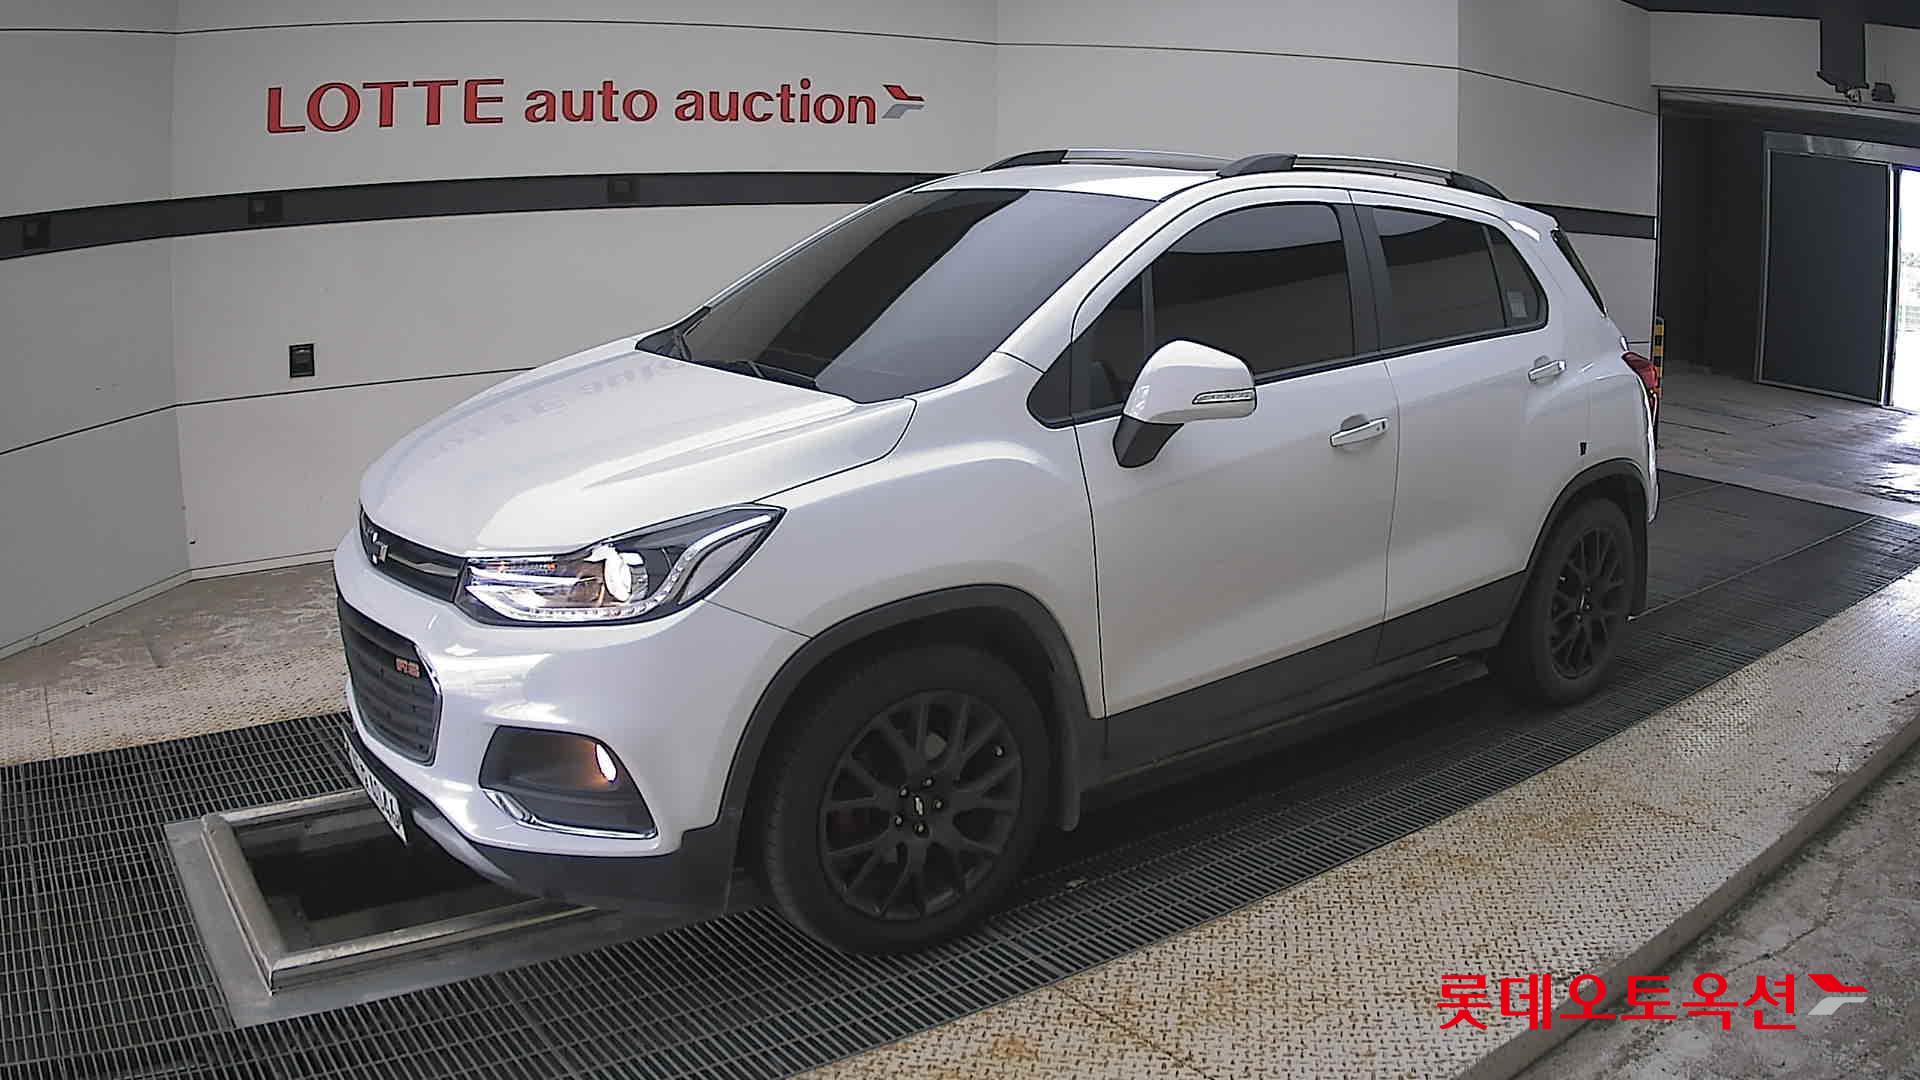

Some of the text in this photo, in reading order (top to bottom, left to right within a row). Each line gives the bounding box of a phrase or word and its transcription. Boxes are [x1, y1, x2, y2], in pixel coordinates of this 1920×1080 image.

[266, 78, 877, 134] LOTTE auto auction
